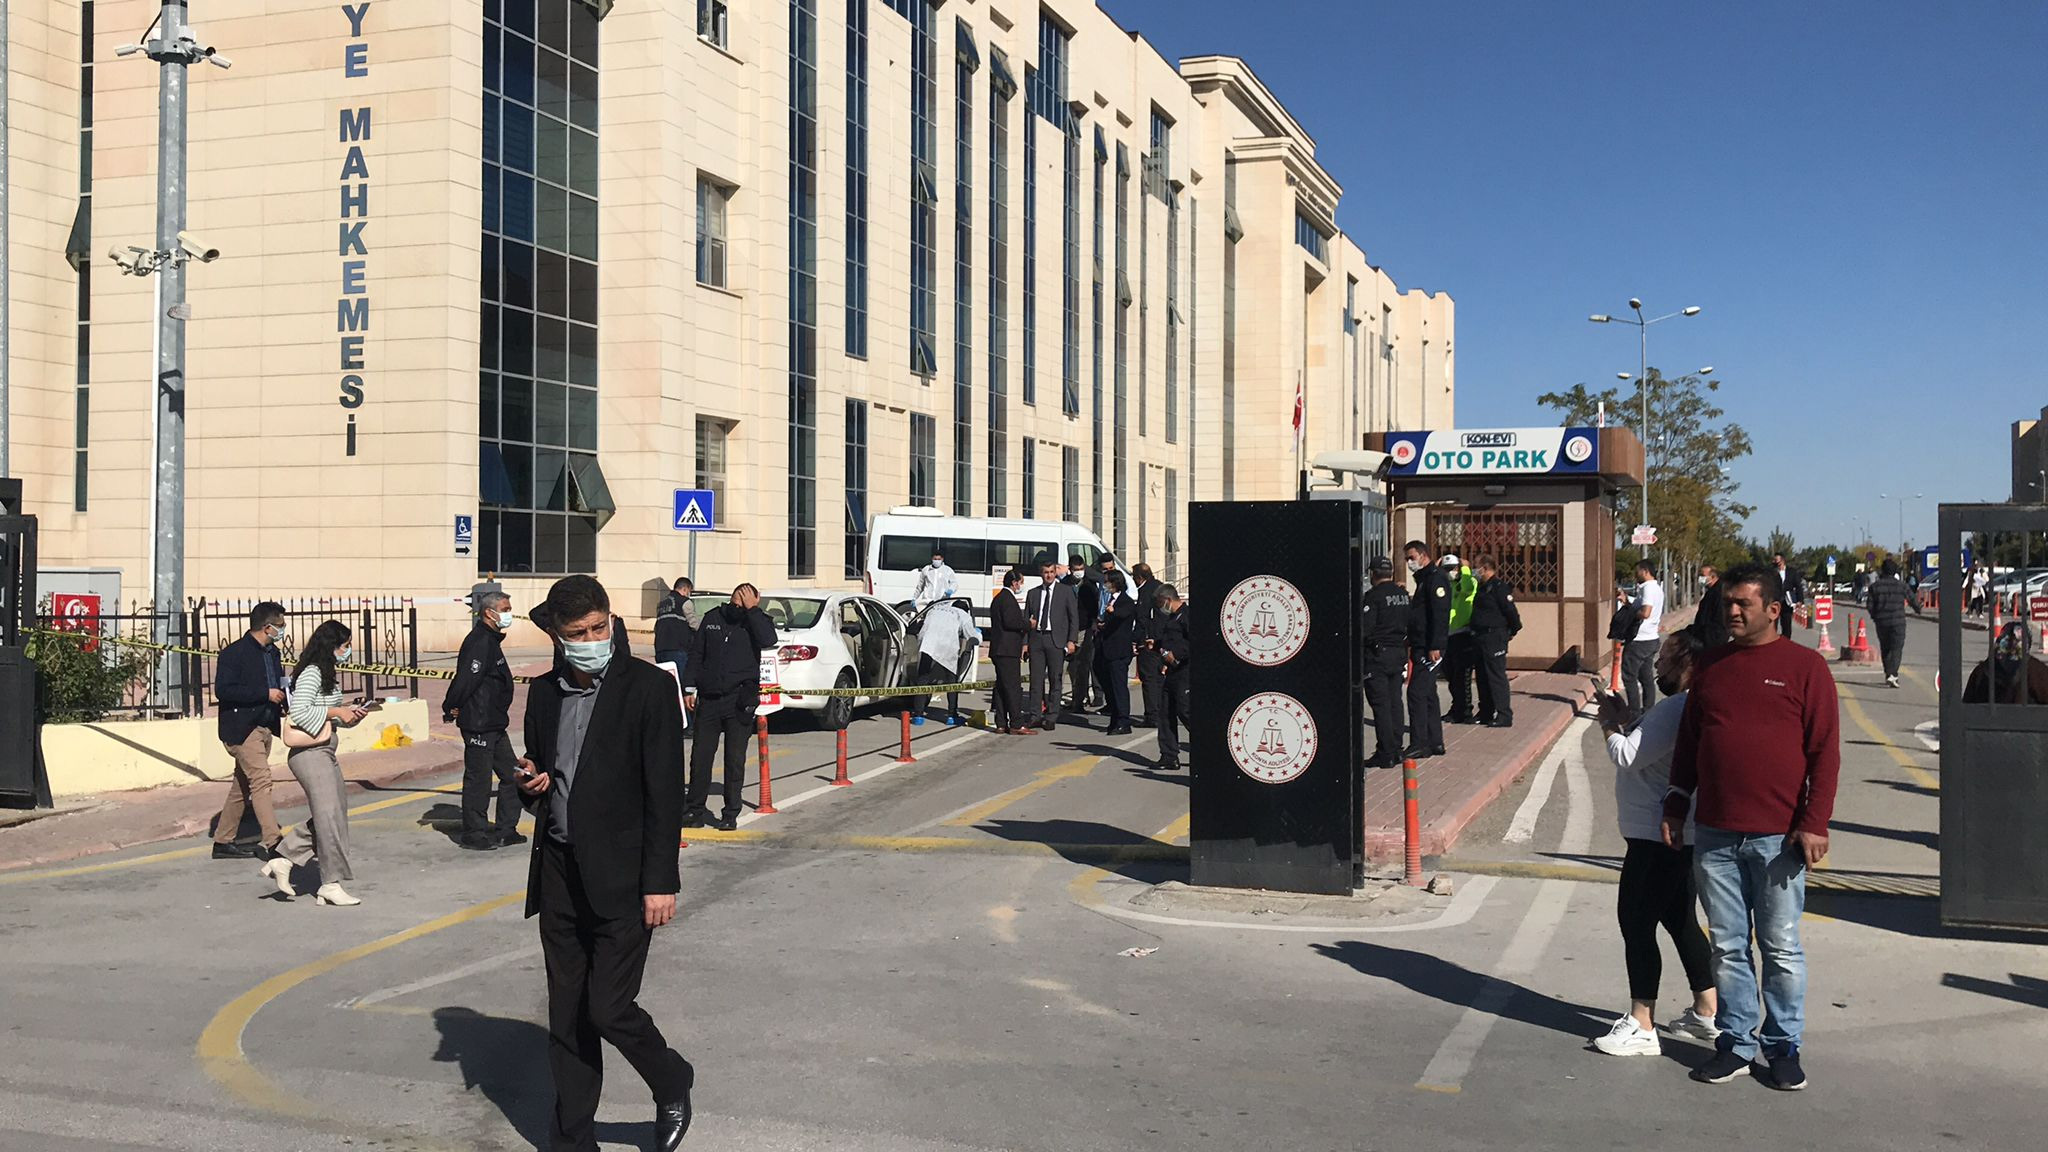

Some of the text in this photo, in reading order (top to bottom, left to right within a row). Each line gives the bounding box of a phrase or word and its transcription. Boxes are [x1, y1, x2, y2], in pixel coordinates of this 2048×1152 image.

[337, 106, 371, 457] MAHKEMESİ
[1424, 450, 1547, 470] OTO PARK
